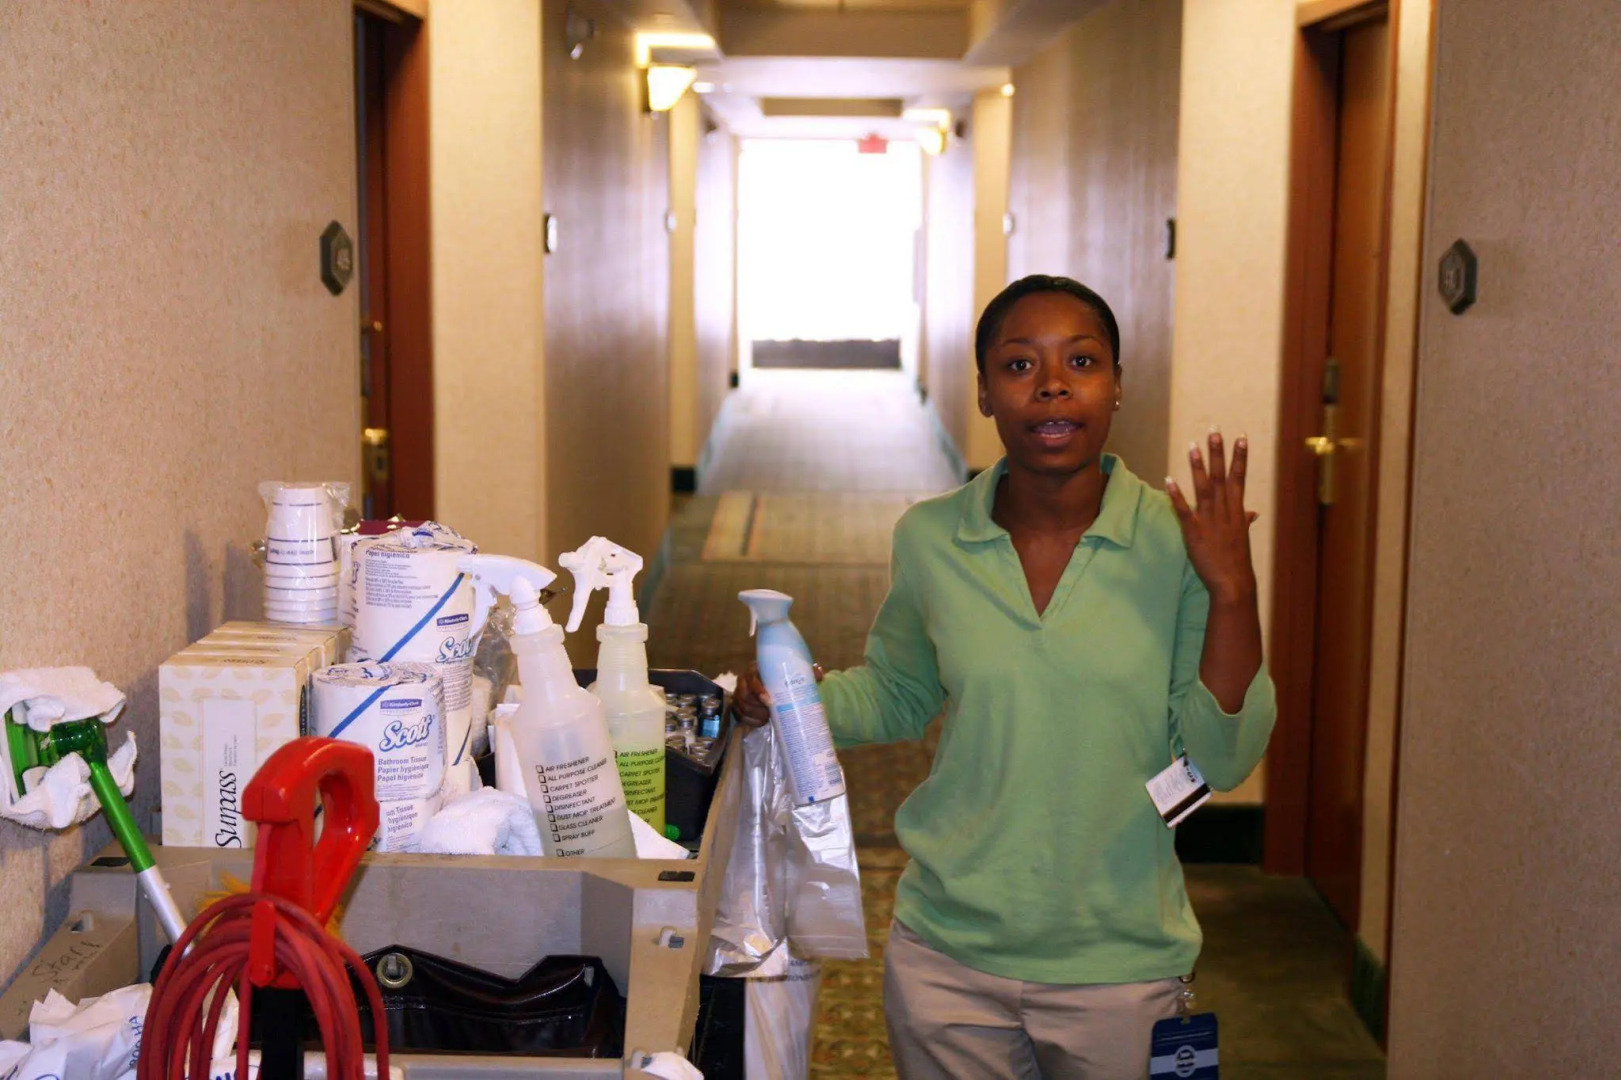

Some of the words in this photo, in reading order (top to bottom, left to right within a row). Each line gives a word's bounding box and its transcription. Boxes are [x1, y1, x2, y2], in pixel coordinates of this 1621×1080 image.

[379, 714, 432, 752] Scott
[556, 756, 590, 770] FRESHENER
[559, 767, 586, 780] PURPOSE
[550, 782, 572, 792] CARPET
[574, 774, 598, 788] SPOTTER
[552, 789, 587, 801] DEGREASER
[215, 770, 242, 848] Surpass
[554, 796, 596, 810] DISINFECTANT
[572, 810, 588, 818] MOP
[590, 797, 616, 812] TREATMENT
[578, 815, 602, 826] CLEANER
